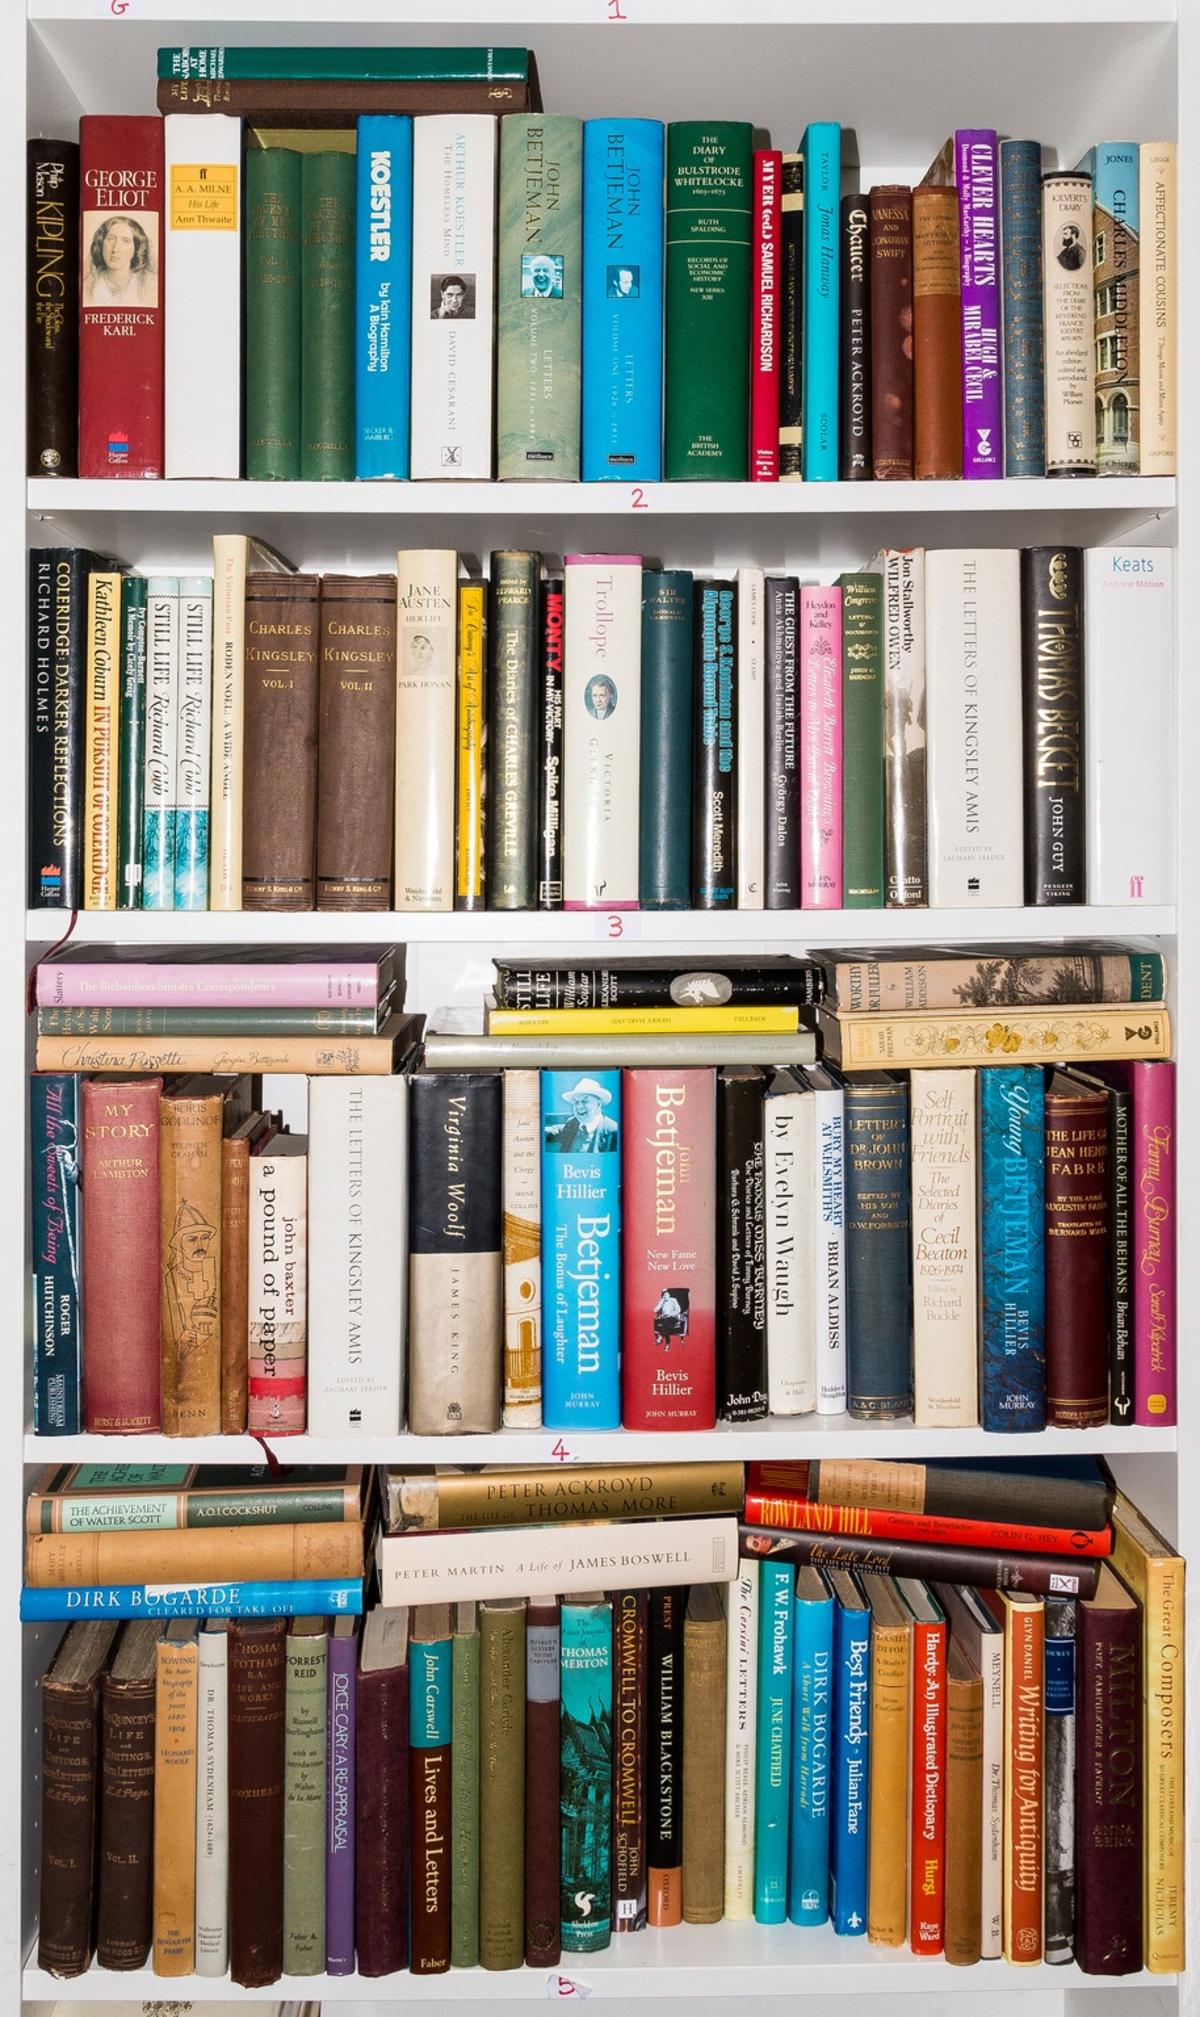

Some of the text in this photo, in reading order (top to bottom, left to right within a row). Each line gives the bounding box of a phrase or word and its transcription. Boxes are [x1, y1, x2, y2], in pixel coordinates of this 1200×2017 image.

[608, 0, 627, 19] 1
[678, 167, 740, 176] BULSTRODE
[692, 146, 726, 155] DIARY
[1106, 155, 1133, 164] JONES
[85, 169, 157, 188] GEORGE
[95, 189, 150, 207] ELIOT
[200, 185, 232, 194] MILNE
[526, 127, 542, 244] BETJEMAN
[546, 160, 560, 211] JOHN
[675, 178, 743, 187] WHITELOCKE
[175, 215, 232, 224] Ann Thwaite
[188, 199, 220, 210] His Life
[370, 151, 391, 262] KOESTLER
[971, 143, 994, 287] CLEVER HEARTS
[36, 201, 64, 299] KIPLING
[760, 159, 774, 372] MYER (ed.) SAMUEL RICHARDSON
[816, 203, 836, 299] Jonas Hanway
[846, 208, 867, 283] Chaucer
[1154, 181, 1166, 328] AFFECTIONATE COUSINS
[84, 313, 155, 325] FREDERICK
[103, 325, 136, 337] KARL
[367, 305, 378, 373] A Biography
[380, 283, 391, 372] by Iain Hamilton
[851, 309, 863, 437] PETER ACKROYD
[632, 489, 648, 508] 2
[1112, 556, 1154, 573] Keats
[400, 598, 452, 609] AUSTEN
[408, 584, 441, 597] JANE
[901, 556, 914, 652] Jon Stallworthy
[249, 622, 312, 635] CHARLES
[546, 594, 562, 672] MONTY
[589, 575, 614, 658] Trollope
[889, 557, 900, 670] WILFRED OWEN
[36, 563, 50, 733] RICHARD HOLMES
[245, 648, 315, 662] KINGSLEY
[53, 562, 72, 847] COLERIDGE: DARKER REFLECTIONS
[148, 603, 171, 796] STILL LIFE Richard Cobb
[263, 680, 287, 689] VOL.
[963, 560, 979, 834] THE LETTERS OF KINGSLEY AMIS
[504, 630, 518, 856] The Diaries of CHARLES GREVILLE
[543, 755, 559, 857] Spike Milligan
[1052, 797, 1063, 872] JOHN GUY
[608, 916, 624, 937] 3
[1140, 962, 1152, 999] DENT
[62, 1041, 188, 1071] Christina Rossetti
[86, 1124, 154, 1138] STORY
[105, 1104, 133, 1117] MY
[443, 1096, 466, 1240] Virginia Woolf
[563, 1164, 600, 1179] Bevis
[646, 1084, 685, 1235] Betjeman
[556, 1185, 607, 1199] Hillier
[769, 1116, 794, 1316] by Evelyn Waugh
[921, 1227, 959, 1244] Cecil
[1002, 1157, 1029, 1294] BETJEMAN
[259, 1165, 279, 1377] a pound of paper
[283, 1217, 296, 1315] john baxter
[647, 1249, 696, 1259] New Fame
[648, 1262, 695, 1270] New Love
[915, 1244, 967, 1260] Beaton
[60, 1294, 70, 1335] ROGER
[554, 1225, 569, 1364] The Bonus of Laughter
[577, 1214, 610, 1373] Betjeman
[828, 1241, 840, 1349] BRIAN ALDISS
[43, 1275, 54, 1356] HUTCHINSON
[449, 1268, 459, 1375] JAMES KING
[1005, 1303, 1016, 1356] HILLIER
[1017, 1310, 1028, 1349] BEVIS
[652, 1384, 692, 1396] Hillier
[657, 1370, 688, 1382] Bevis
[551, 1438, 570, 1461] 4
[70, 1504, 167, 1515] THE ACHIEVEMENT
[487, 1477, 654, 1499] PETER ACKROYD
[525, 1496, 678, 1517] THOMAS MORE
[70, 1515, 161, 1527] OF WALTER SCOTT
[569, 1552, 691, 1571] JAMES BOSWELL
[67, 1588, 240, 1607] DIRK BOGARDE
[925, 1633, 940, 1676] Hardy:
[1155, 1572, 1179, 1759] The Great Composers
[424, 1652, 439, 1740] John Carswell
[621, 1595, 636, 1826] CROMWELL TO CROMWELL
[925, 1679, 940, 1700] An
[660, 1653, 673, 1840] WILLIAM BLACKSTONE
[847, 1640, 867, 1835] Best Friends Julian Fane
[924, 1704, 939, 1768] Illustrated
[922, 1770, 939, 1841] Dictionary
[1015, 1685, 1040, 1892] Writing for Antiquity
[425, 1756, 443, 1914] Lives and Letters
[420, 1957, 446, 1969] Faber
[558, 1978, 575, 1995] 5
